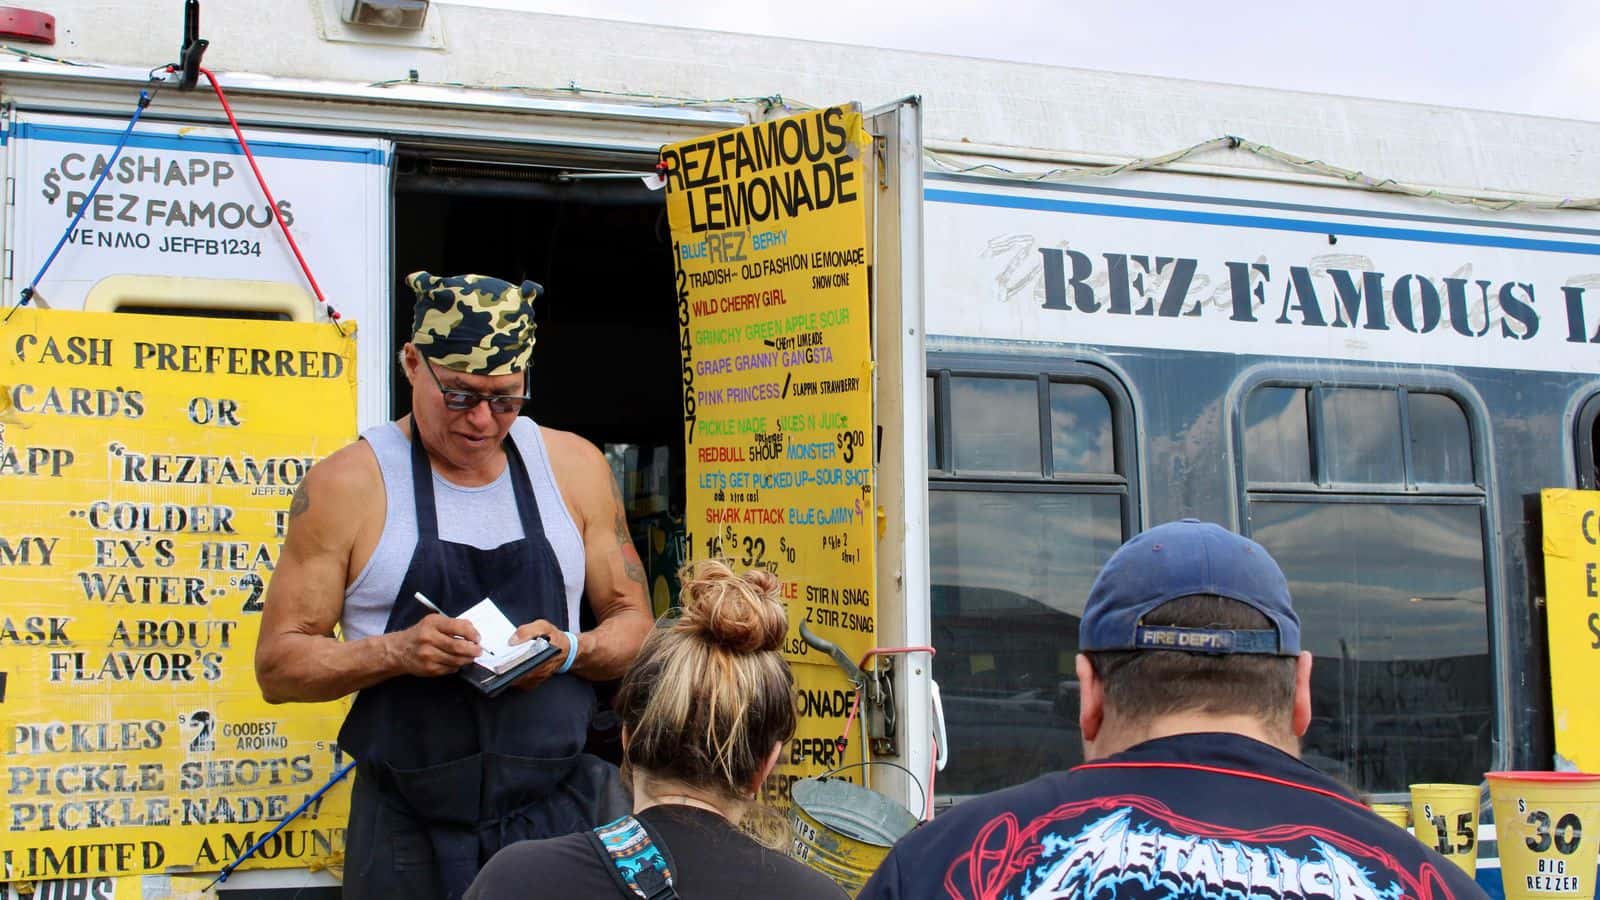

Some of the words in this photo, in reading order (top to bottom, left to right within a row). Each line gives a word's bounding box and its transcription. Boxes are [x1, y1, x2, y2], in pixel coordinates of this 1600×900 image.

[663, 107, 847, 193] REZFAMOUS
[687, 155, 857, 233] LEMONADE
[67, 228, 150, 249] VENMO
[160, 236, 261, 257] JEFFB1234
[681, 241, 707, 260] BLUE
[741, 262, 762, 280] OLD
[763, 253, 808, 276] FASHION
[811, 247, 864, 268] LEMONADE
[812, 275, 832, 289] SNOW
[1038, 247, 1199, 318] REZ
[1225, 261, 1540, 341] FAMOUS
[692, 299, 718, 317] WILD
[720, 292, 761, 313] CHERRY
[762, 289, 787, 307] GIRL
[696, 327, 741, 346] GRINCHY
[745, 320, 783, 340] GREEN
[785, 313, 816, 333] APPLE
[820, 307, 849, 329] SOUR
[15, 334, 113, 367] CASH
[134, 342, 344, 379] PREFERRED
[696, 357, 733, 377] GRAPE
[735, 351, 779, 371] GRANNY
[782, 346, 834, 367] GANGSTA
[13, 383, 145, 418] CARD'S
[188, 397, 241, 427] OR
[685, 386, 696, 415] 6
[698, 389, 723, 407] PINK
[727, 383, 781, 403] PRINCESS
[820, 378, 860, 394] STRAWBERRY
[685, 415, 696, 445] 7
[698, 418, 736, 437] PICKLE
[738, 416, 767, 433] NADE
[786, 440, 836, 461] MONSTER
[251, 486, 276, 496] JEFF
[699, 471, 727, 490] LET'S
[730, 472, 749, 488] GET
[845, 468, 870, 487] SHOT
[706, 507, 740, 524] SHARK
[743, 508, 785, 525] ATTACK
[0, 537, 60, 567] MY
[95, 535, 176, 569] EX'S
[200, 542, 284, 572] HEA
[742, 536, 768, 568] 32
[806, 585, 829, 605] STIR
[831, 590, 839, 605] N
[842, 588, 870, 607] SNAG
[0, 616, 73, 647] ASK
[107, 619, 237, 650] ABOUT
[806, 607, 813, 623] Z
[817, 607, 839, 628] STIR
[849, 614, 874, 633] SNAG
[1143, 630, 1175, 645] FIRE
[50, 651, 223, 682] FLAVOR'S
[8, 719, 166, 755] PICKLES
[223, 722, 278, 737] GOODEST
[8, 763, 165, 795] PICKLE
[180, 754, 314, 791] SHOTS
[795, 817, 815, 841] TIPS
[4, 841, 166, 877] LIMITED
[1028, 806, 1390, 900] METALLICA
[1538, 859, 1565, 874] BIG
[1527, 876, 1578, 891] REZZER
